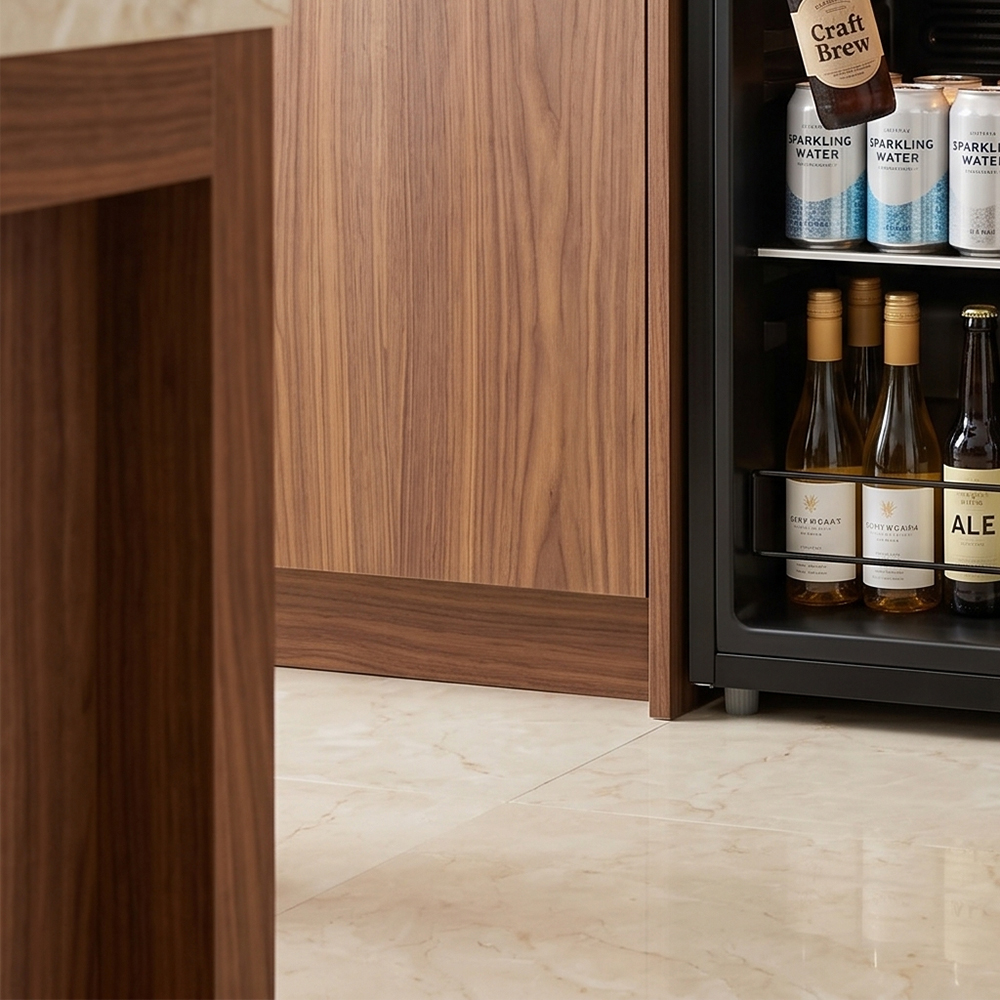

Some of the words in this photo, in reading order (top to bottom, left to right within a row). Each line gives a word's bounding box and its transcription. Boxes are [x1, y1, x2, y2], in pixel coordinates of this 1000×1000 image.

[811, 13, 865, 42] Craft
[815, 37, 869, 62] Brew
[788, 134, 852, 147] SPARKLING
[869, 138, 934, 150] SPARKLING
[796, 148, 839, 160] WATER
[876, 152, 919, 163] WATER
[951, 514, 996, 535] ALE
